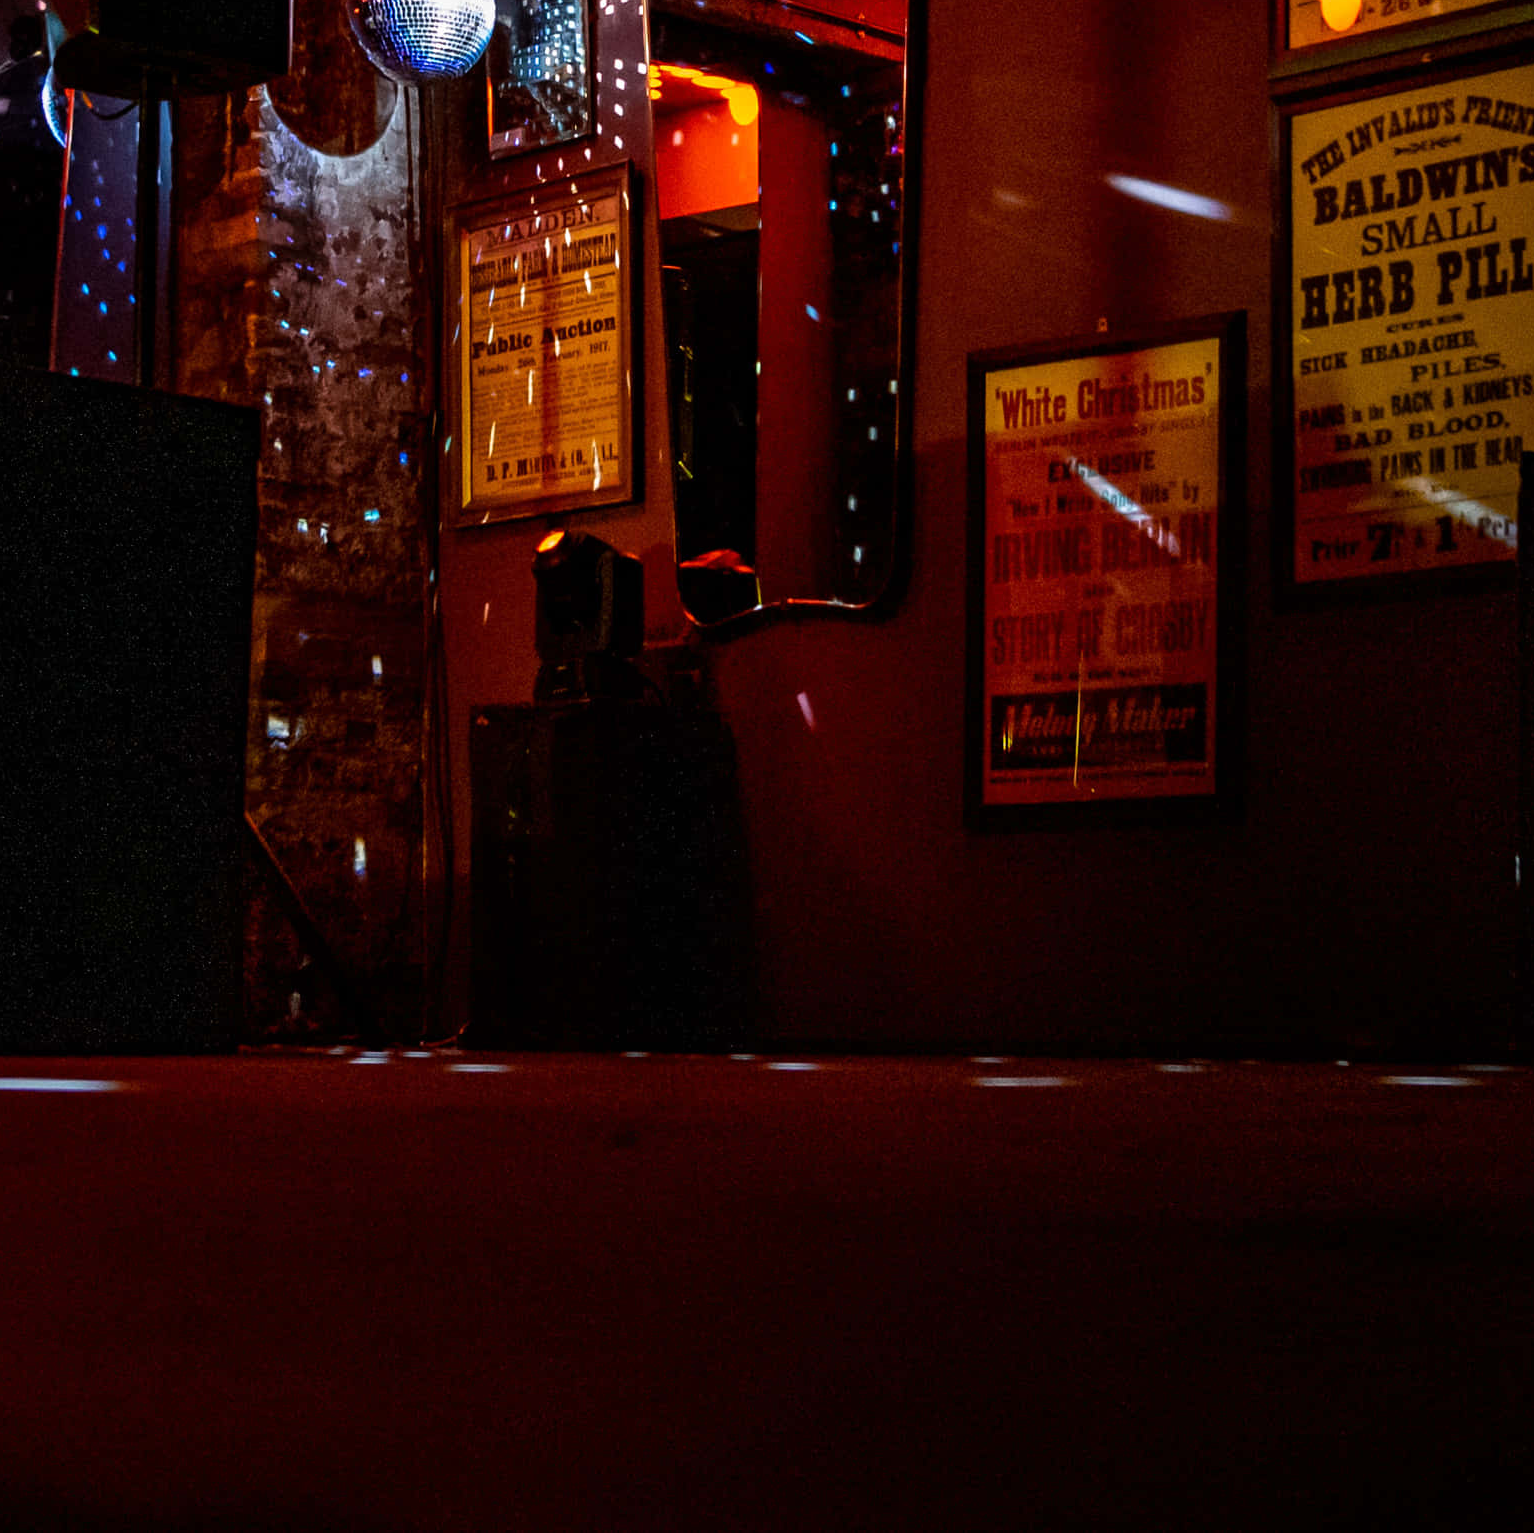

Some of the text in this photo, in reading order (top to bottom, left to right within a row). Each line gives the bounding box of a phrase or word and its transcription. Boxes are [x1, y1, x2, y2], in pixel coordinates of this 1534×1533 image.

[1301, 140, 1345, 184] THE
[1345, 98, 1455, 156] INVALID'S
[1361, 201, 1497, 257] SMALL
[1300, 259, 1414, 329] HERB
[472, 316, 616, 360] Public Auction
[1300, 352, 1348, 375] SICK
[1300, 404, 1345, 430] PAINS
[1352, 406, 1363, 422] in
[1369, 405, 1384, 420] the
[1391, 389, 1434, 416] BACK
[1335, 429, 1392, 451] BAD
[1048, 449, 1156, 484] EXCLUSIVE
[1380, 451, 1423, 483] PAINS
[1430, 447, 1446, 474] IN
[1453, 443, 1477, 470] THE
[1182, 478, 1200, 503] by
[992, 522, 1094, 584] IRVING
[992, 610, 1065, 666] STORY
[1116, 597, 1209, 656] CROSBY
[1104, 692, 1196, 734] Maker
